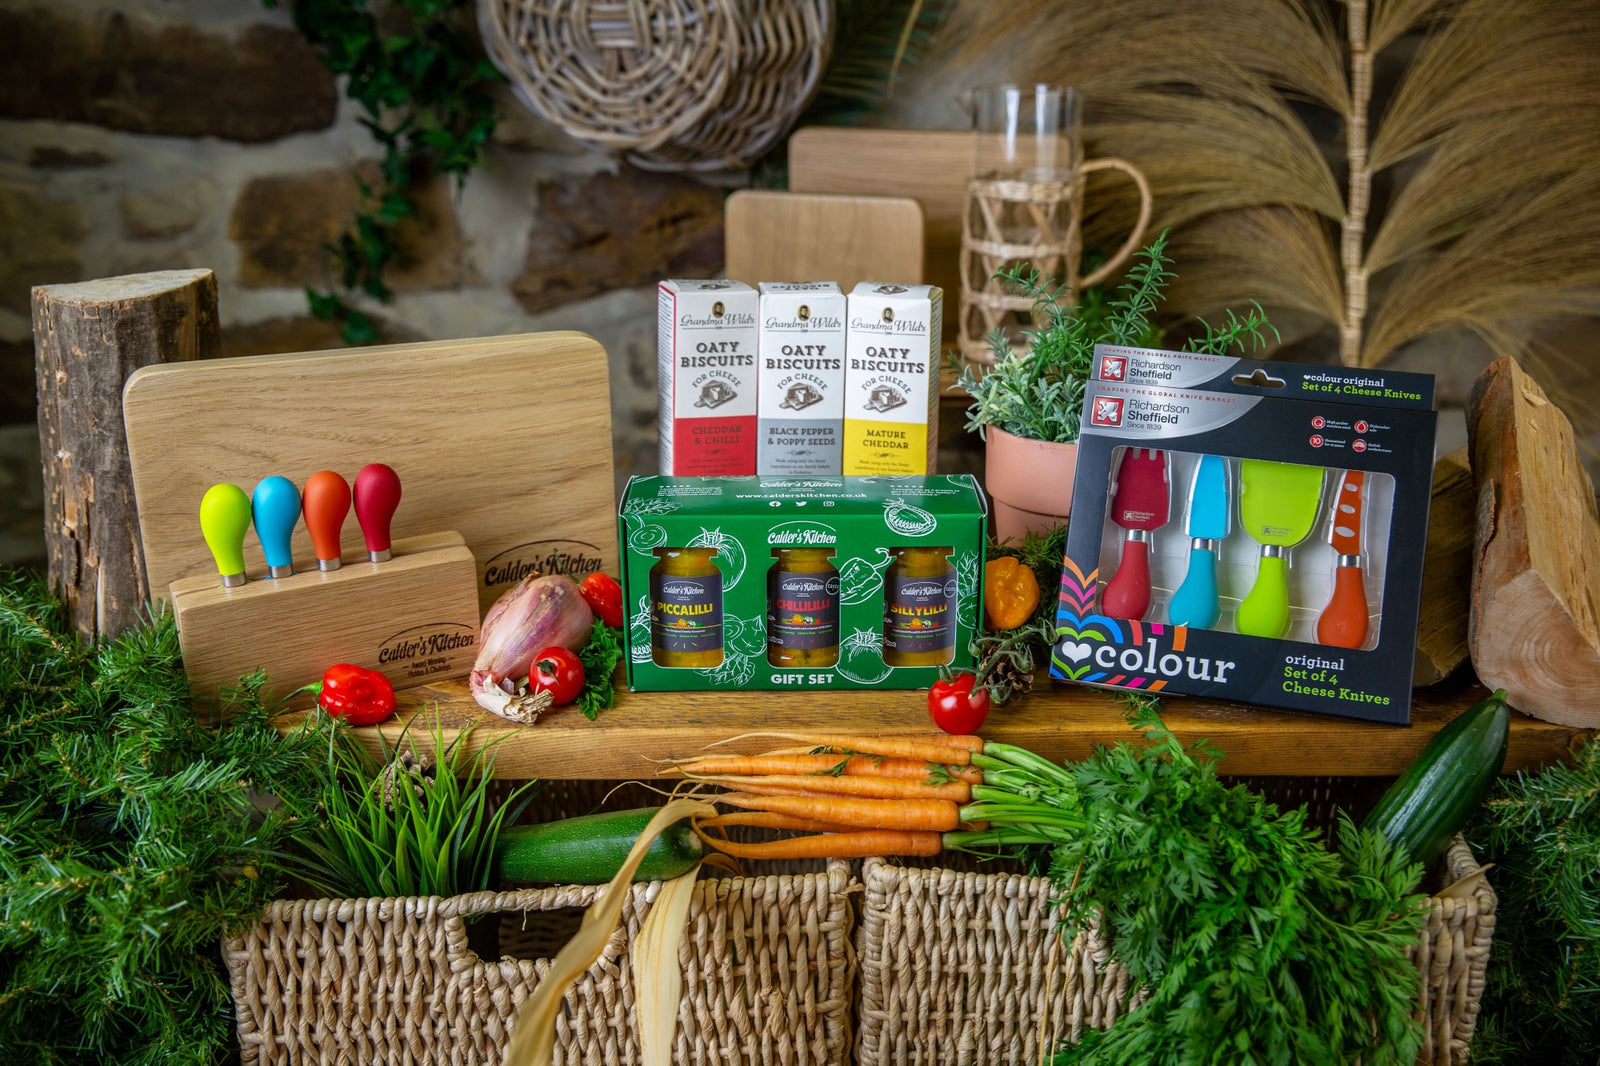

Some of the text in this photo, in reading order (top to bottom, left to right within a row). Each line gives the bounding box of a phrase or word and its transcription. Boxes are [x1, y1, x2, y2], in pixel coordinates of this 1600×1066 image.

[680, 313, 755, 326] Grandma Wild's
[765, 317, 842, 328] Grandma Wild's
[851, 318, 926, 332] Grandma Wild's
[696, 342, 740, 354] OATY
[781, 345, 826, 356] OATY
[866, 346, 910, 359] OATY
[680, 355, 754, 368] BISCUITS
[766, 358, 840, 370] BISCUITS
[851, 358, 925, 374] BISCUITS
[1130, 358, 1181, 371] Richardson
[692, 370, 742, 388] FOR CHEESE
[1130, 368, 1172, 380] Sheffield
[1310, 373, 1384, 387] colour original
[777, 374, 828, 390] FOR CHEESE
[861, 375, 912, 394] FOR CHEESE
[1149, 390, 1177, 398] GLOBAL
[1302, 382, 1421, 400] Set of 4 Cheese Knives
[1129, 399, 1190, 414] Richardson
[1128, 410, 1178, 424] Sheffield
[692, 426, 742, 434] CHEDDAR
[770, 428, 834, 436] BLACK PEPPER
[866, 430, 906, 438] MATURE
[704, 436, 740, 444] CHILLI
[862, 440, 909, 449] CHEDDAR
[768, 529, 836, 544] Calder's Kitchen
[484, 553, 602, 586] Calder's Kitchen
[658, 602, 713, 616] PICCALILLI
[891, 603, 948, 616] SILLYLILLI
[378, 632, 474, 664] Calder's Kitchen
[428, 657, 446, 665] Winning
[1095, 638, 1236, 683] colour
[1285, 655, 1344, 670] original
[771, 674, 834, 684] GIFT SET
[1284, 666, 1337, 685] Set of 4
[1282, 681, 1390, 705] Cheese Knives
